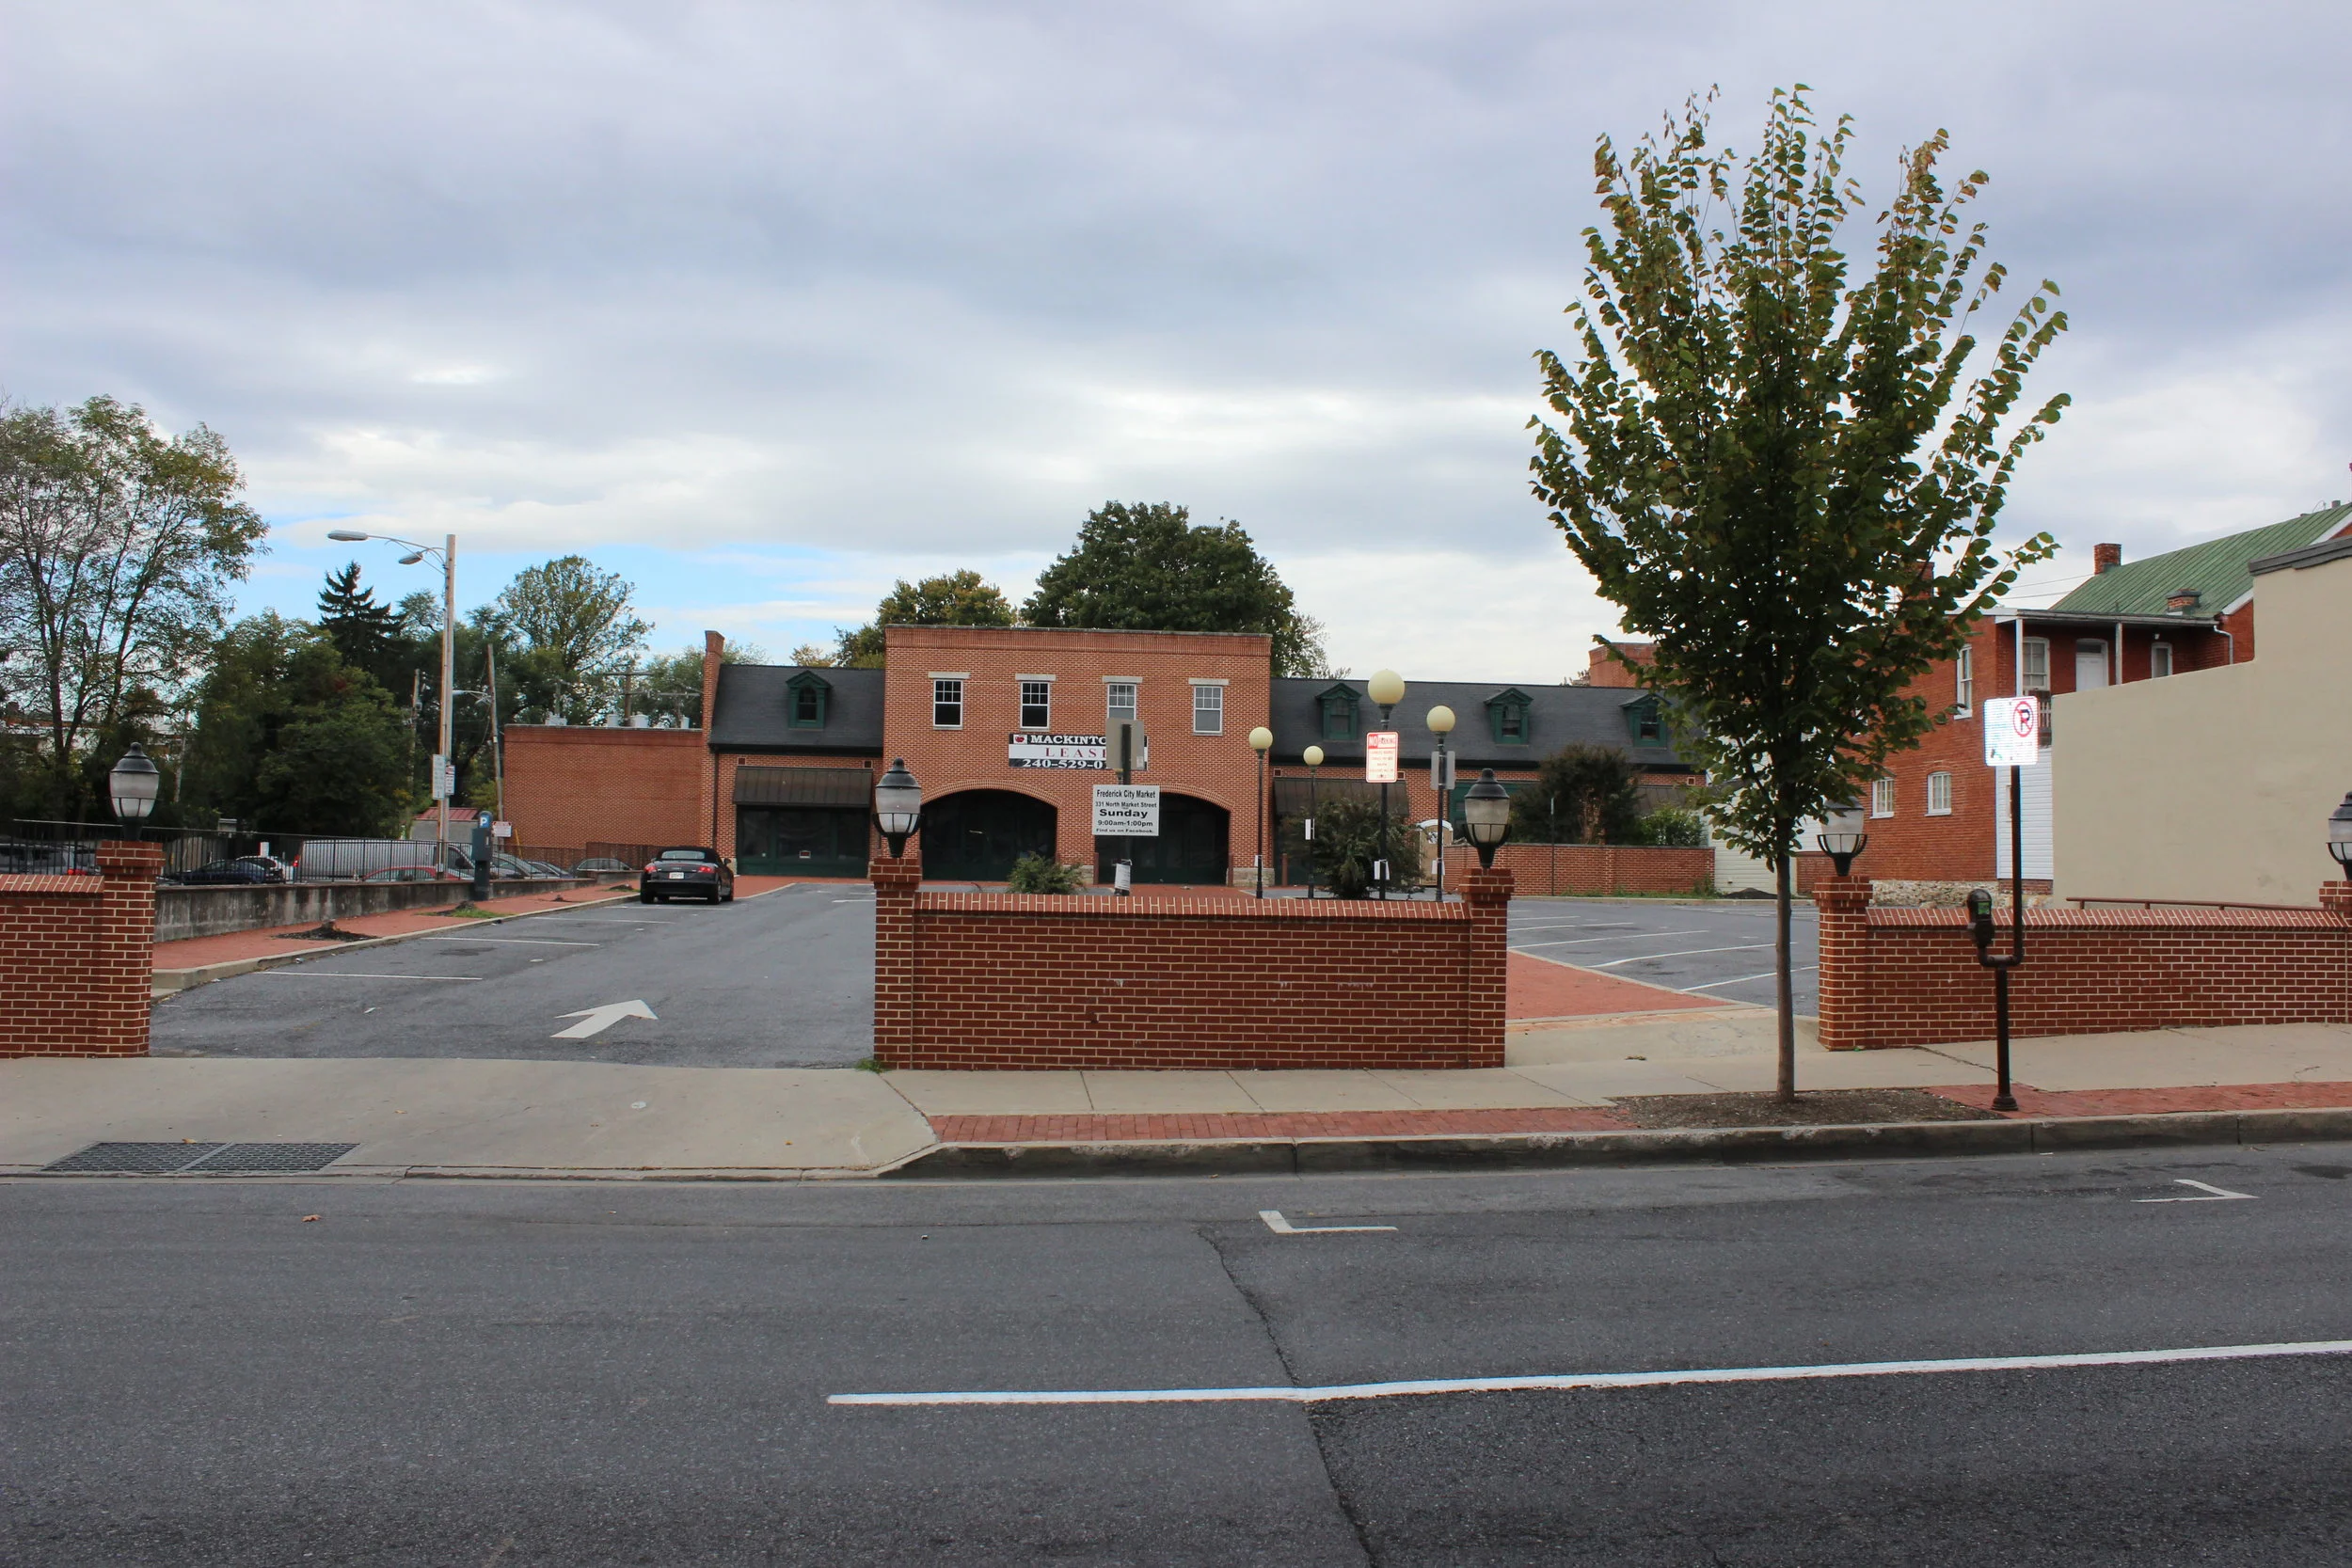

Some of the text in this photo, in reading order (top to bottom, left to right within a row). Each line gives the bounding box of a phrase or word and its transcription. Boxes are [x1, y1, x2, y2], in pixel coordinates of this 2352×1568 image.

[1369, 736, 1377, 746] NO
[1022, 758, 1106, 769] 240-529-0
[1096, 789, 1156, 800] Frederick City Market
[1099, 809, 1148, 819] Sunday
[1097, 819, 1153, 828] 9:00am-1:00pm
